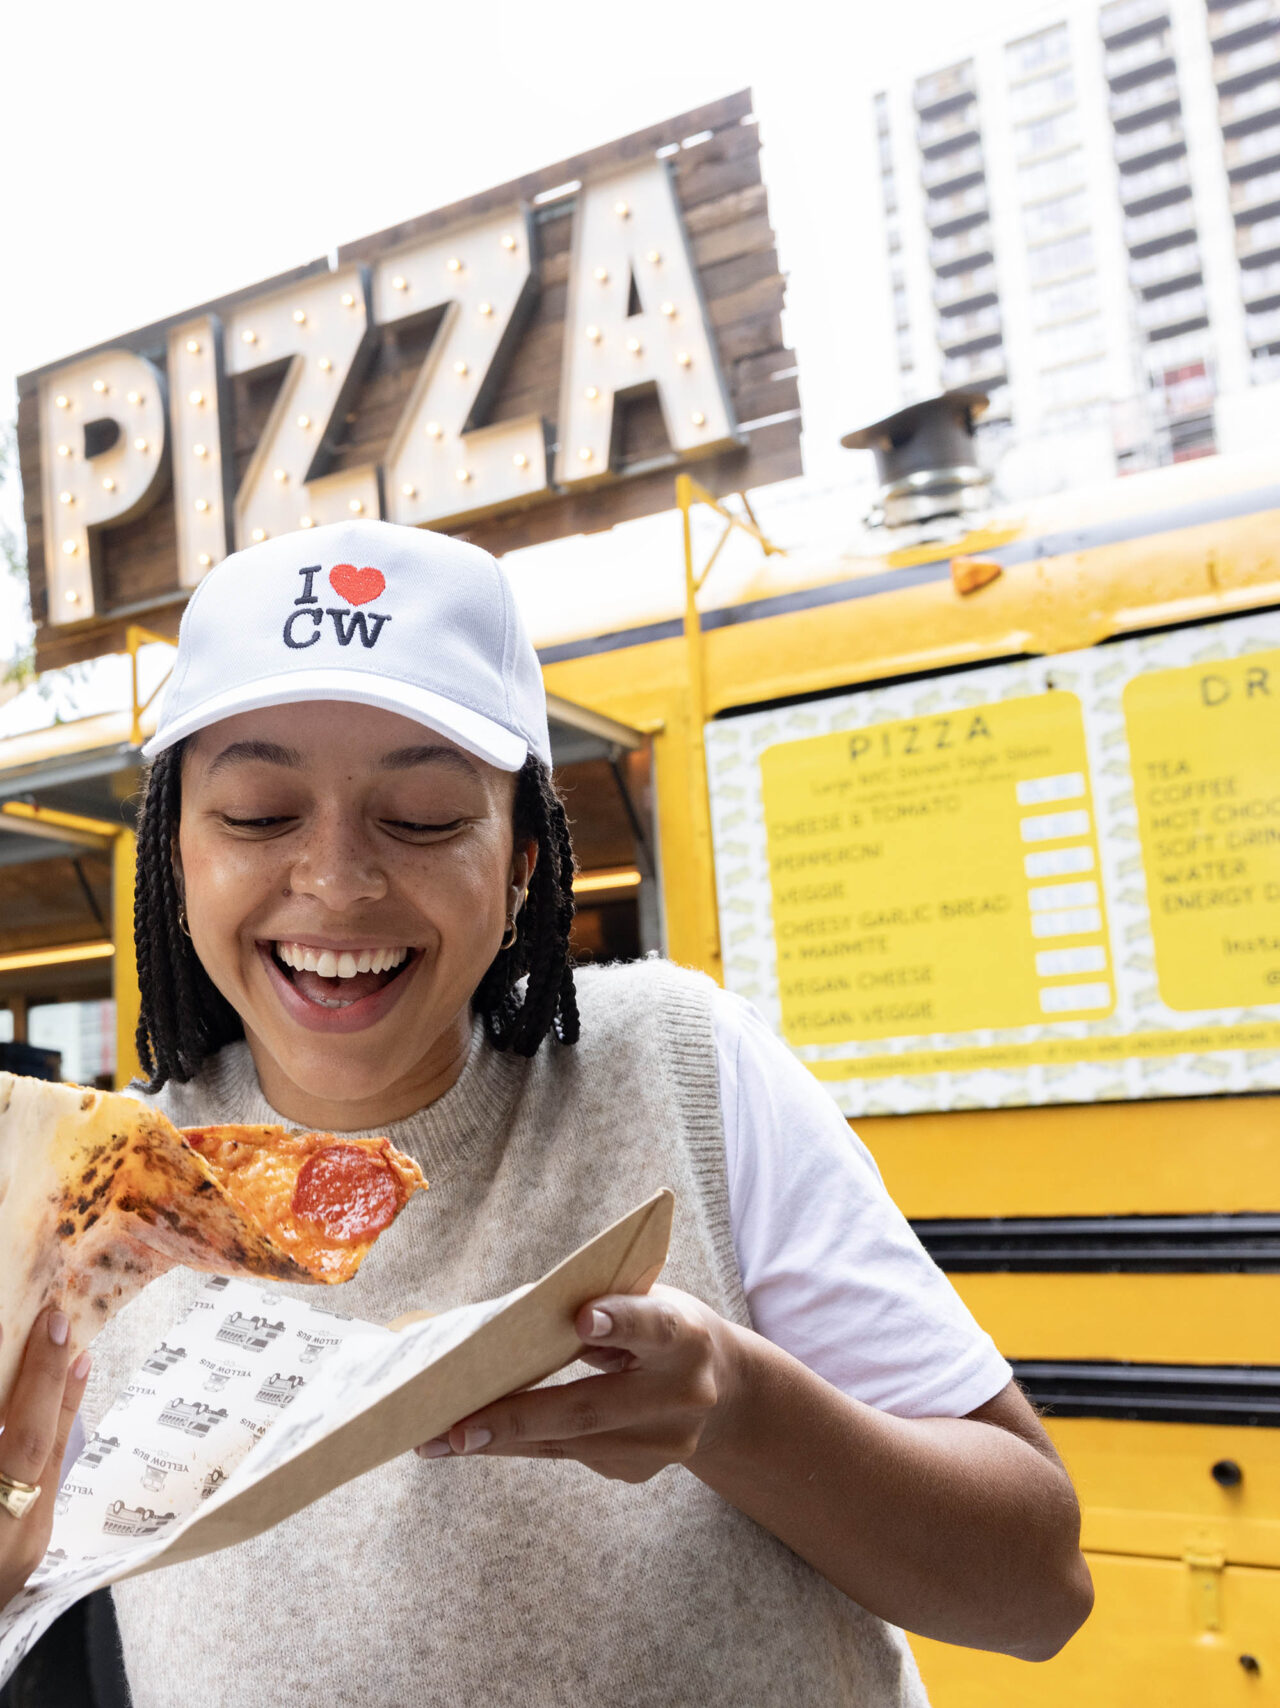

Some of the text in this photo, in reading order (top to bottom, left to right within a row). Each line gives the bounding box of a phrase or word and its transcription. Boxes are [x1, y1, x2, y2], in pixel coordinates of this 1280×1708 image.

[39, 158, 738, 627] PIZZA
[294, 565, 322, 605] I
[283, 608, 392, 648] CW
[848, 715, 993, 762] PIZZA
[1144, 759, 1192, 780] TEA
[1148, 775, 1239, 807] COFFEE
[769, 812, 841, 841] CHEESE
[872, 795, 962, 823] TOMATO
[1161, 858, 1247, 885] WATER
[858, 903, 933, 929] GARLIC
[939, 893, 1011, 919] BREAD
[1162, 887, 1254, 915] ENERGY
[799, 934, 888, 960] MARMITE
[783, 964, 932, 998] VEGAN CHEESE
[786, 1009, 854, 1032] VEGAN
[296, 1330, 312, 1341] BUS
[199, 1358, 252, 1377] YELLOW BUS
[132, 1447, 190, 1473] YELLOW BUS
